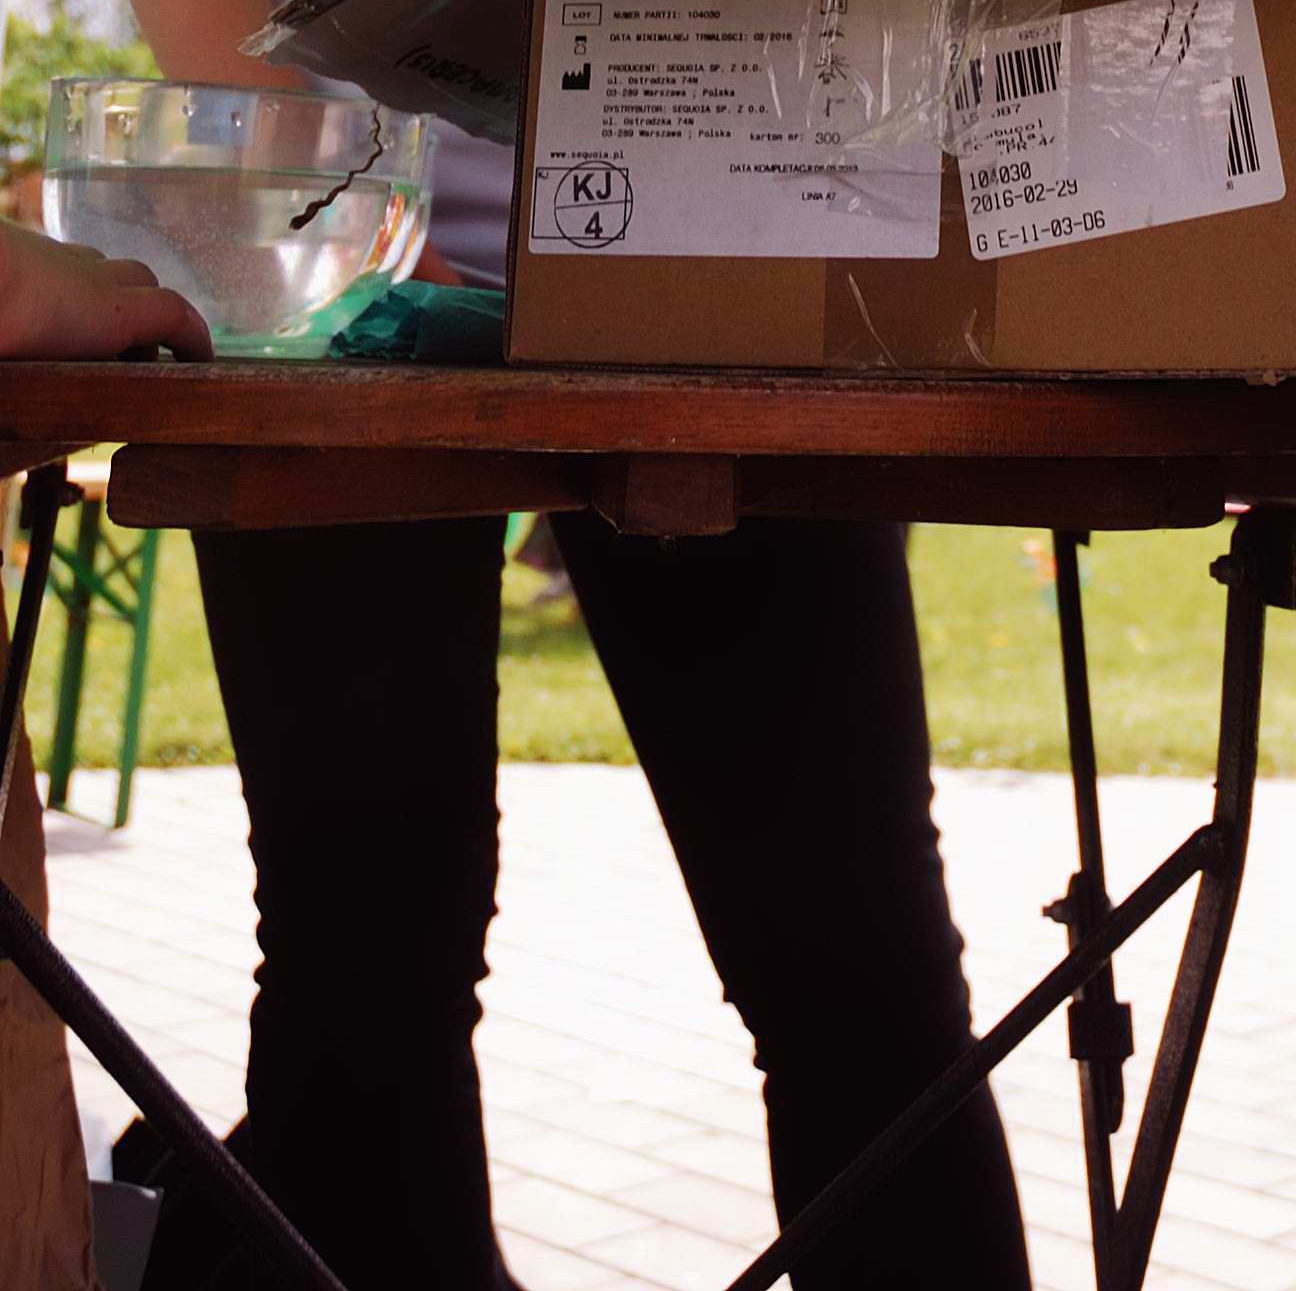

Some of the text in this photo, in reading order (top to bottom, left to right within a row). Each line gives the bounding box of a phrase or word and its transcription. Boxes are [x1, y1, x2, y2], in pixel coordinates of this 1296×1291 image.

[571, 11, 592, 20] LOT
[613, 11, 641, 21] NUMER
[609, 32, 632, 43] DATA
[635, 32, 690, 42] MINIMALNEJ
[607, 63, 661, 73] PRODUCENT:
[666, 63, 705, 73] SEQUOIA
[709, 63, 725, 73] SP.
[607, 75, 623, 86] ul.
[643, 88, 687, 98] Warszawa
[701, 88, 736, 98] Polska
[671, 104, 711, 115] SEQUOIA
[715, 105, 732, 115] SP.
[602, 116, 618, 127] ul.
[638, 129, 682, 139] Warszawa
[697, 128, 732, 139] Polska
[749, 130, 784, 142] karton
[814, 132, 841, 146] 300
[549, 149, 625, 161] www.sequoia.pl
[729, 163, 752, 174] DATA
[968, 161, 1033, 191] 104030
[572, 171, 613, 203] KJ
[970, 178, 1079, 215] 2016-02-29
[583, 210, 604, 240] 4
[976, 209, 1106, 253] G E-11-03-D6
